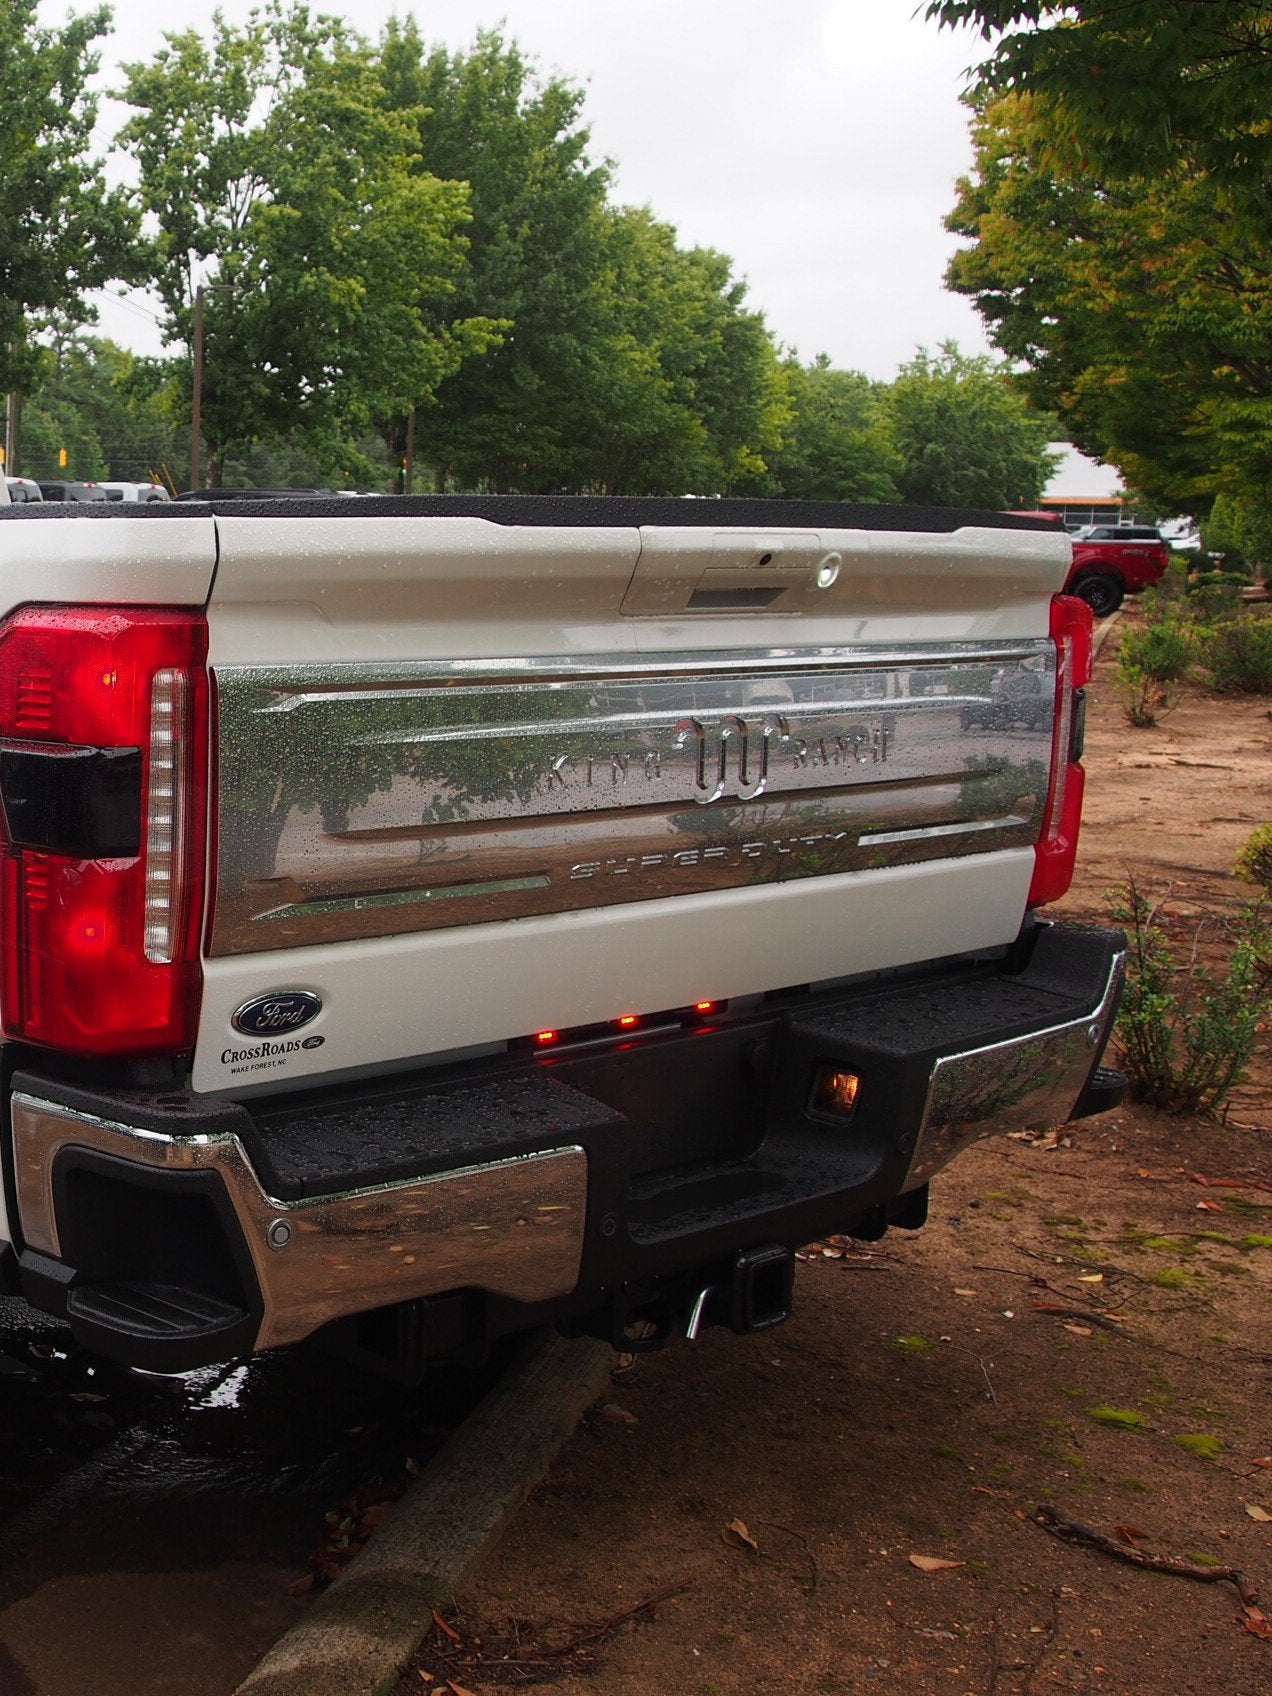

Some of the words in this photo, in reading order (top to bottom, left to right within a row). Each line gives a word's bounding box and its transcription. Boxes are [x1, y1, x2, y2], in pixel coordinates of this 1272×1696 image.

[230, 1065, 250, 1075] WAKE
[250, 1060, 277, 1071] FOREST,
[277, 1058, 288, 1067] NC
